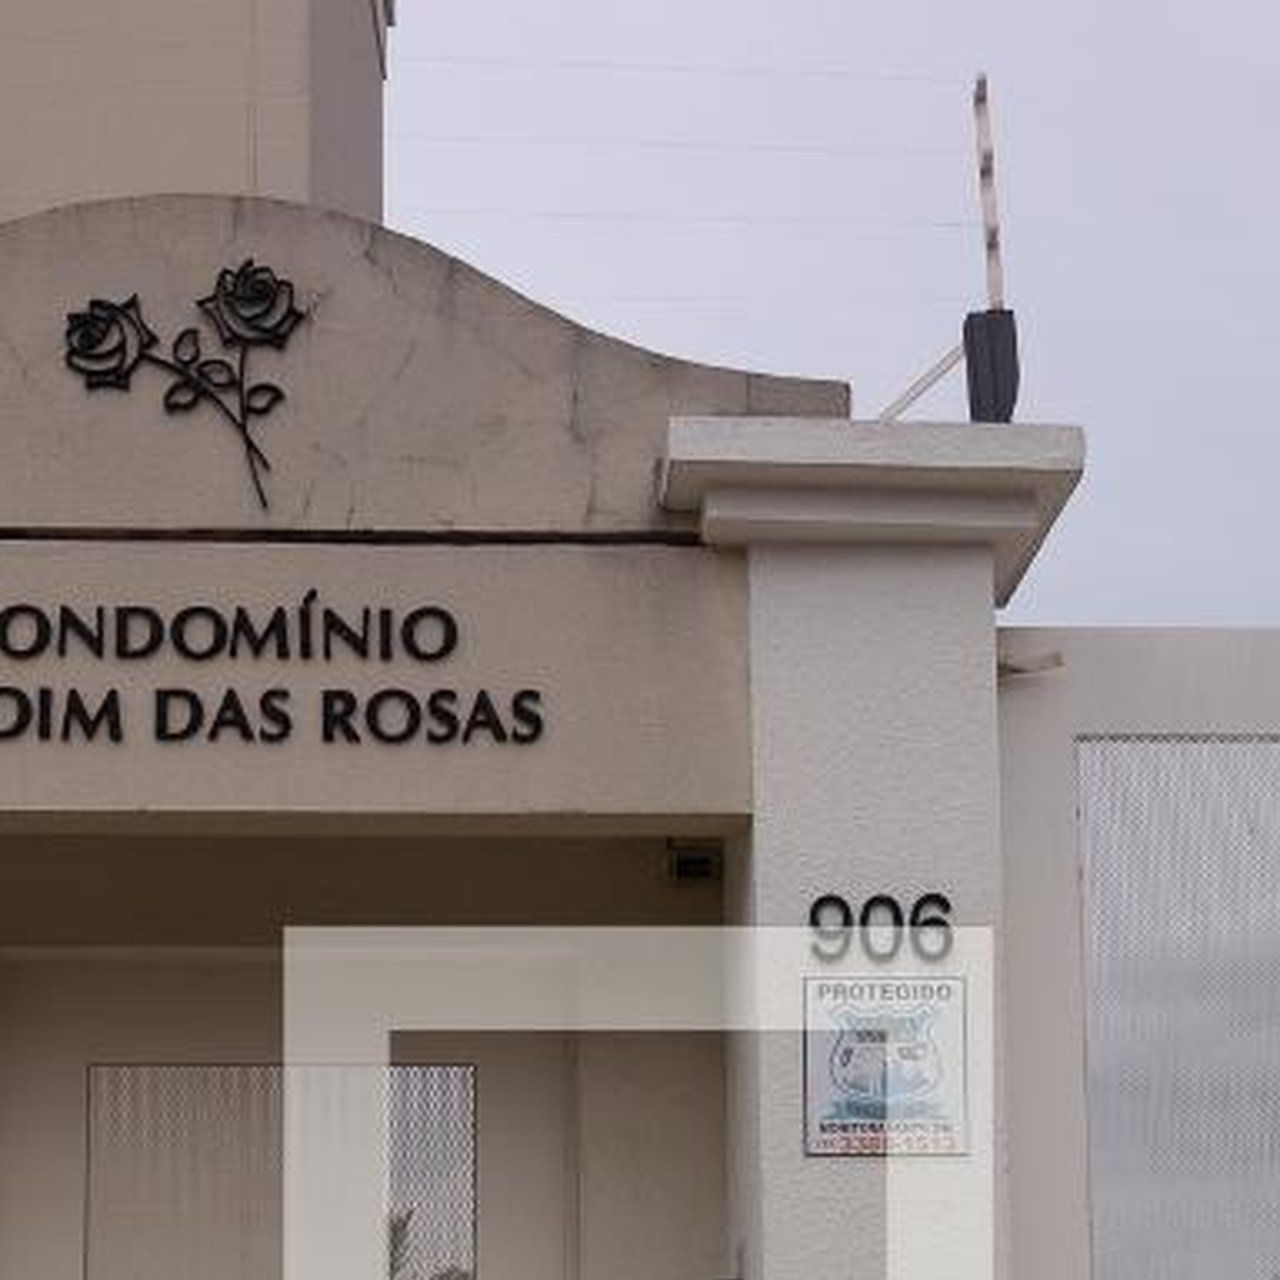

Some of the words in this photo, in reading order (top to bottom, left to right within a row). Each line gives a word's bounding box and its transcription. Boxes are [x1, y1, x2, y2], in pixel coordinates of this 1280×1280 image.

[154, 688, 293, 745] DAS
[321, 688, 544, 746] ROSAS
[809, 892, 953, 963] 906
[818, 982, 952, 1001] PROTEGIDO
